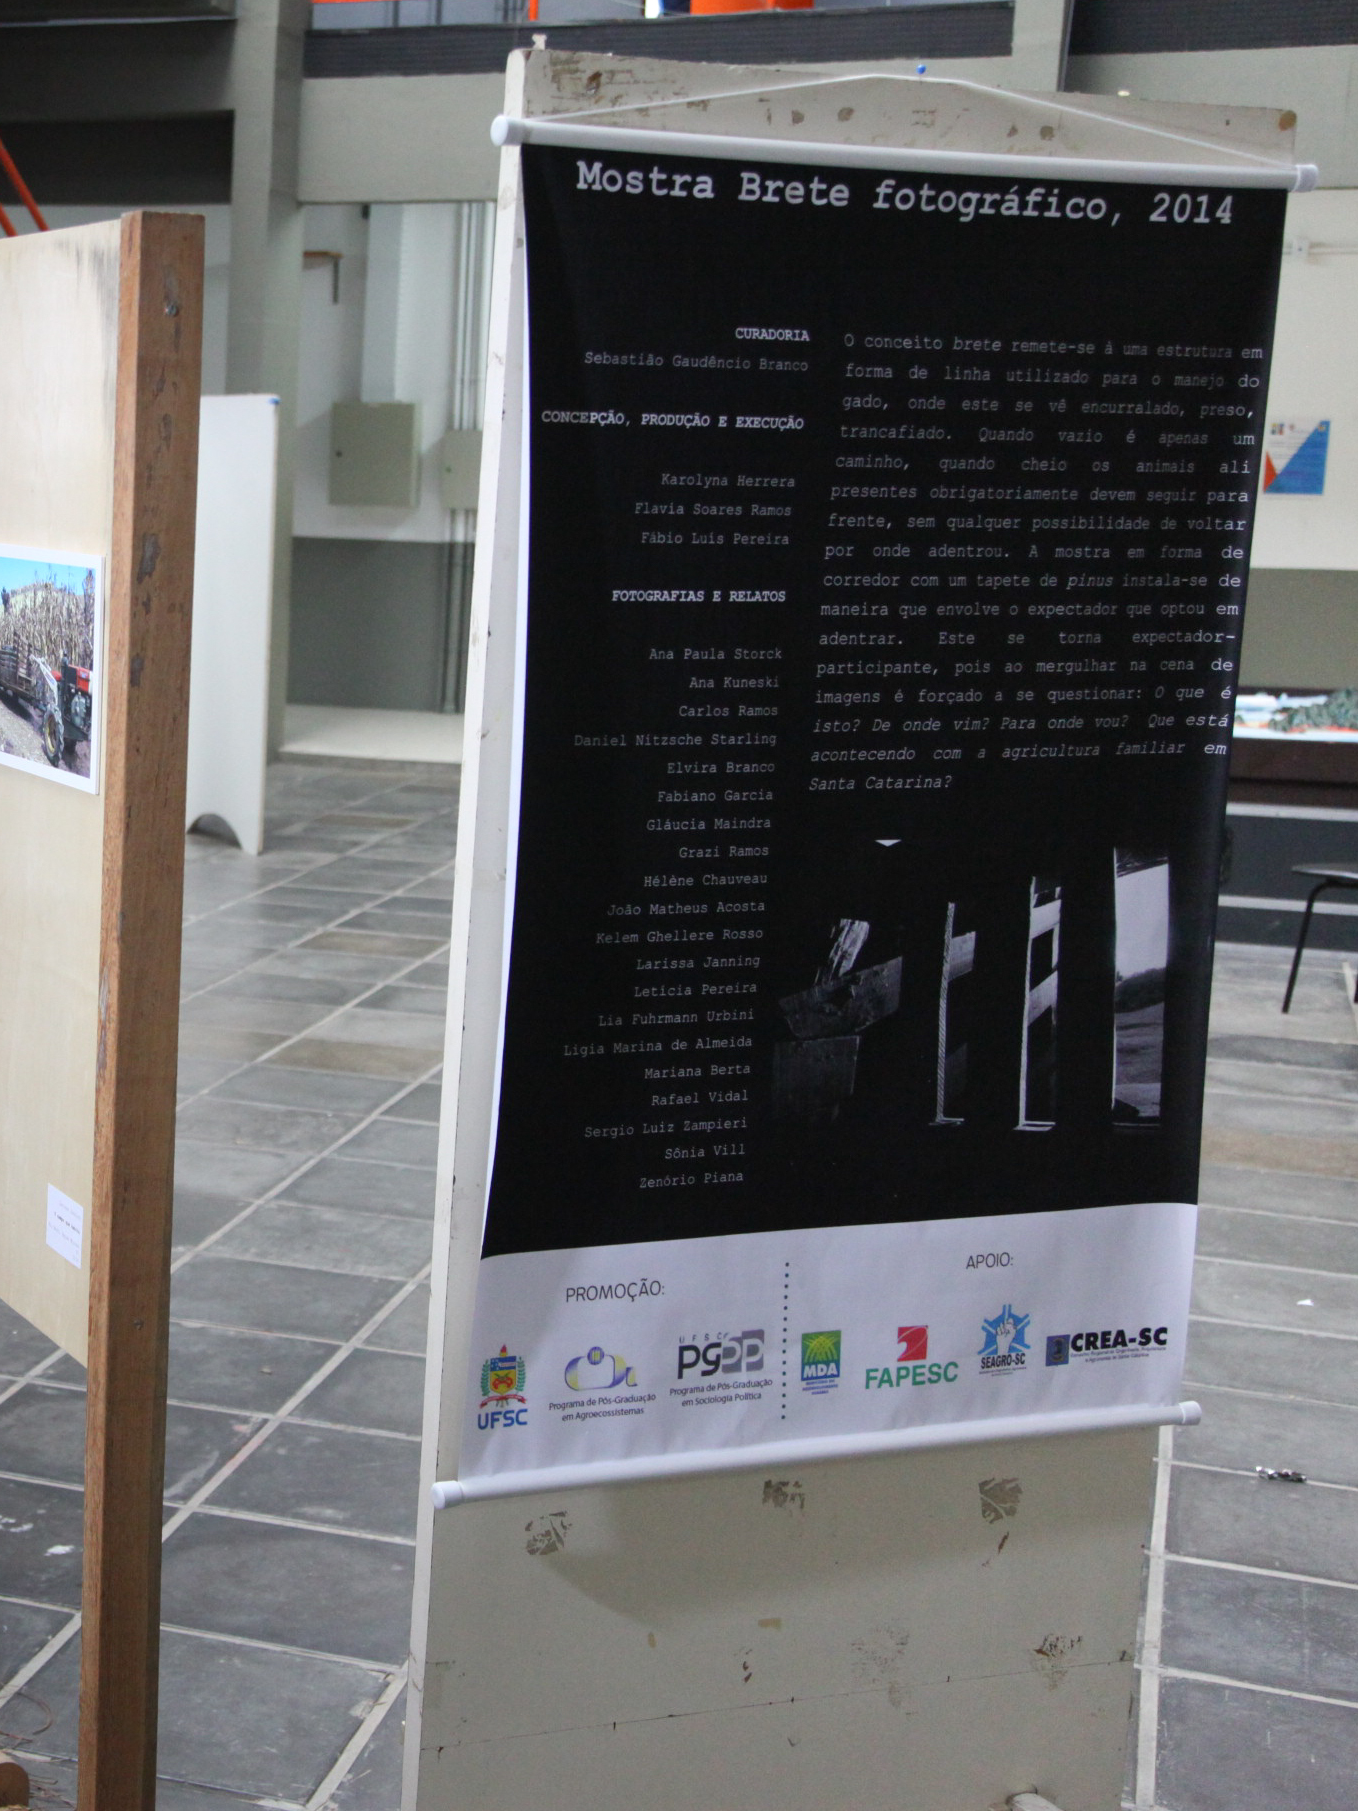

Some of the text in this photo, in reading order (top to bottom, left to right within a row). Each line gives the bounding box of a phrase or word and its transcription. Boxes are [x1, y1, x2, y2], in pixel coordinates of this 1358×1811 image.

[576, 160, 1234, 227] Mostra Brete fotográfico, 2014
[734, 326, 810, 342] CURADORIA
[863, 333, 1095, 355] conceito brete remete-se
[583, 350, 808, 371] Sebastião Gaudêncio Branco
[844, 362, 1090, 384] forma linha utilizado
[842, 392, 1254, 420] gado, preso,
[540, 407, 804, 432] CONCEPÇÃO, PRODUÇÃO E EXECUÇÃO
[977, 426, 1034, 443] Quando
[1057, 427, 1103, 443] vazio
[1232, 433, 1256, 445] um
[834, 452, 1251, 474] caminho, cheio ali
[660, 472, 795, 489] Karolyna Herrera
[829, 484, 1078, 504] presentes obrigatoriamente
[692, 502, 742, 516] Soares
[750, 503, 791, 516] Ramos
[827, 512, 1247, 533] frente, sem qualquer possibilidade voltar
[640, 530, 683, 544] Fábio
[732, 531, 789, 545] Pereira
[823, 542, 1009, 560] por adentrou.
[822, 572, 1241, 590] corredor com tapete pinus instala-se de
[611, 589, 786, 602] FOTOGRAFIAS E RELATOS
[819, 601, 1118, 619] maneira envolve expectador
[818, 630, 903, 645] adentrar.
[937, 630, 975, 645] Este
[648, 646, 782, 660] Ana Paula Storck
[816, 657, 1117, 678] participante, pois mergulhar
[688, 675, 714, 688] Ana
[814, 689, 880, 707] imagens
[917, 687, 982, 705] forçado
[678, 703, 778, 717] Carlos Ramos
[812, 713, 1229, 733] isto? vim? Para está
[573, 732, 777, 747] Daniel Nitzsche Starling
[810, 745, 962, 762] acontecendo com
[666, 760, 775, 774] Elvira Branco
[808, 774, 952, 791] Santa Catarina?
[657, 787, 773, 802] Fabiano Garcia
[645, 817, 706, 831] Gláucia
[678, 844, 769, 858] Grazi Ramos
[701, 872, 767, 885] Chauveau
[606, 899, 765, 916] João Matheus Acosta
[721, 927, 763, 940] Rosso
[635, 953, 760, 970] Larissa Janning
[700, 981, 757, 995] Pereira
[597, 1007, 754, 1027] Lia Fuhrmann Urbini
[612, 1039, 662, 1054] Marina
[670, 1038, 688, 1051] de
[694, 1034, 752, 1049] Almeida
[644, 1062, 751, 1079] Mariana Berta
[650, 1088, 748, 1106] Rafael Vidal
[642, 1119, 674, 1134] Luiz
[664, 1142, 745, 1159] Sônia Vill
[703, 1169, 744, 1184] Piana
[966, 1252, 1013, 1269] APOIO:
[566, 1278, 665, 1303] PROMOÇÃO:
[1071, 1327, 1168, 1352] CREA-SC
[981, 1353, 1026, 1370] SEAGRO-SC
[803, 1363, 838, 1379] MDA
[865, 1361, 959, 1389] FAPESC
[669, 1379, 773, 1396] Programa de Pós-Graduação
[549, 1393, 656, 1411] Programa de Pós-Graduação
[682, 1399, 693, 1407] em
[695, 1394, 732, 1404] Sociologia
[477, 1409, 528, 1430] UFSC
[562, 1408, 644, 1421] em Agroecossistemas
